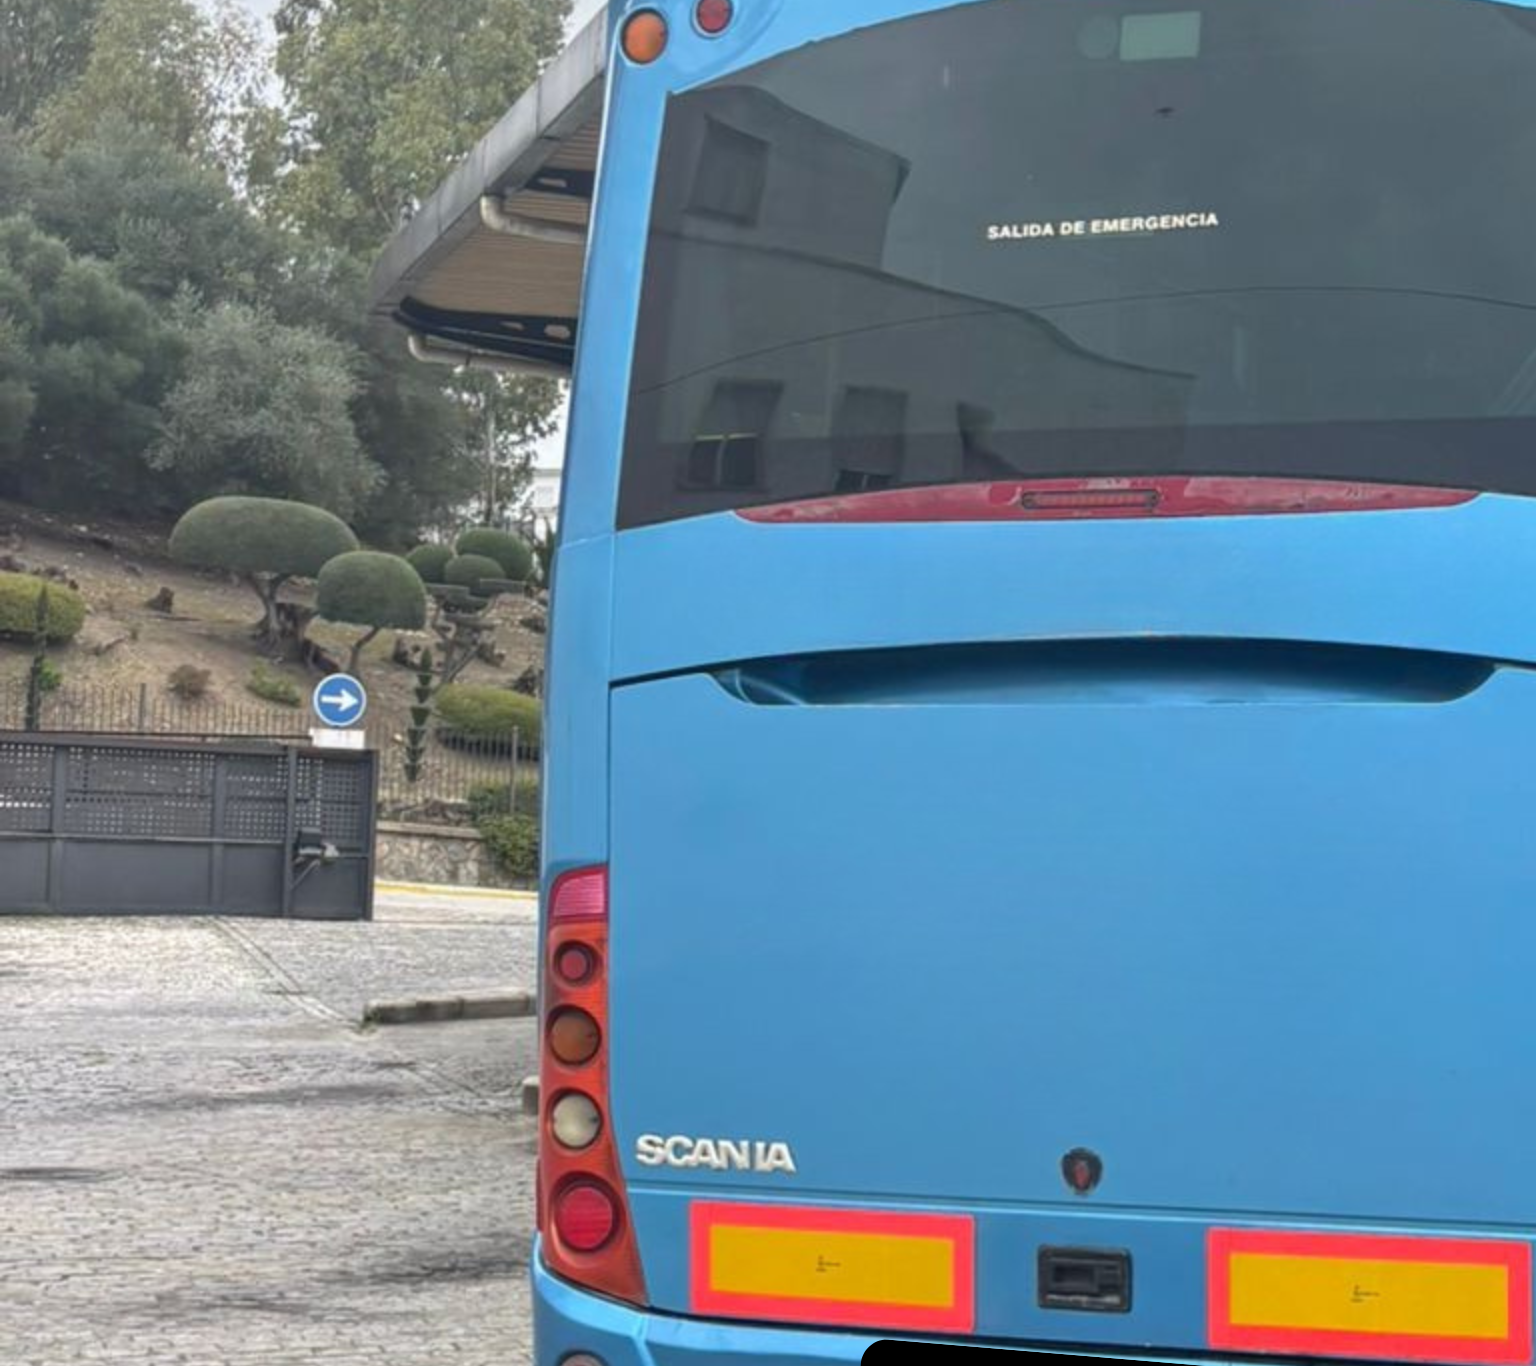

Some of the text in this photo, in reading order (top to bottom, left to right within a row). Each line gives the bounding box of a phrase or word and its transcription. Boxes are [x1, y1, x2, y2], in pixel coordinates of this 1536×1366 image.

[987, 212, 1219, 240] SALIDA DE EMERGENCIA
[636, 1134, 797, 1173] SCANIA
